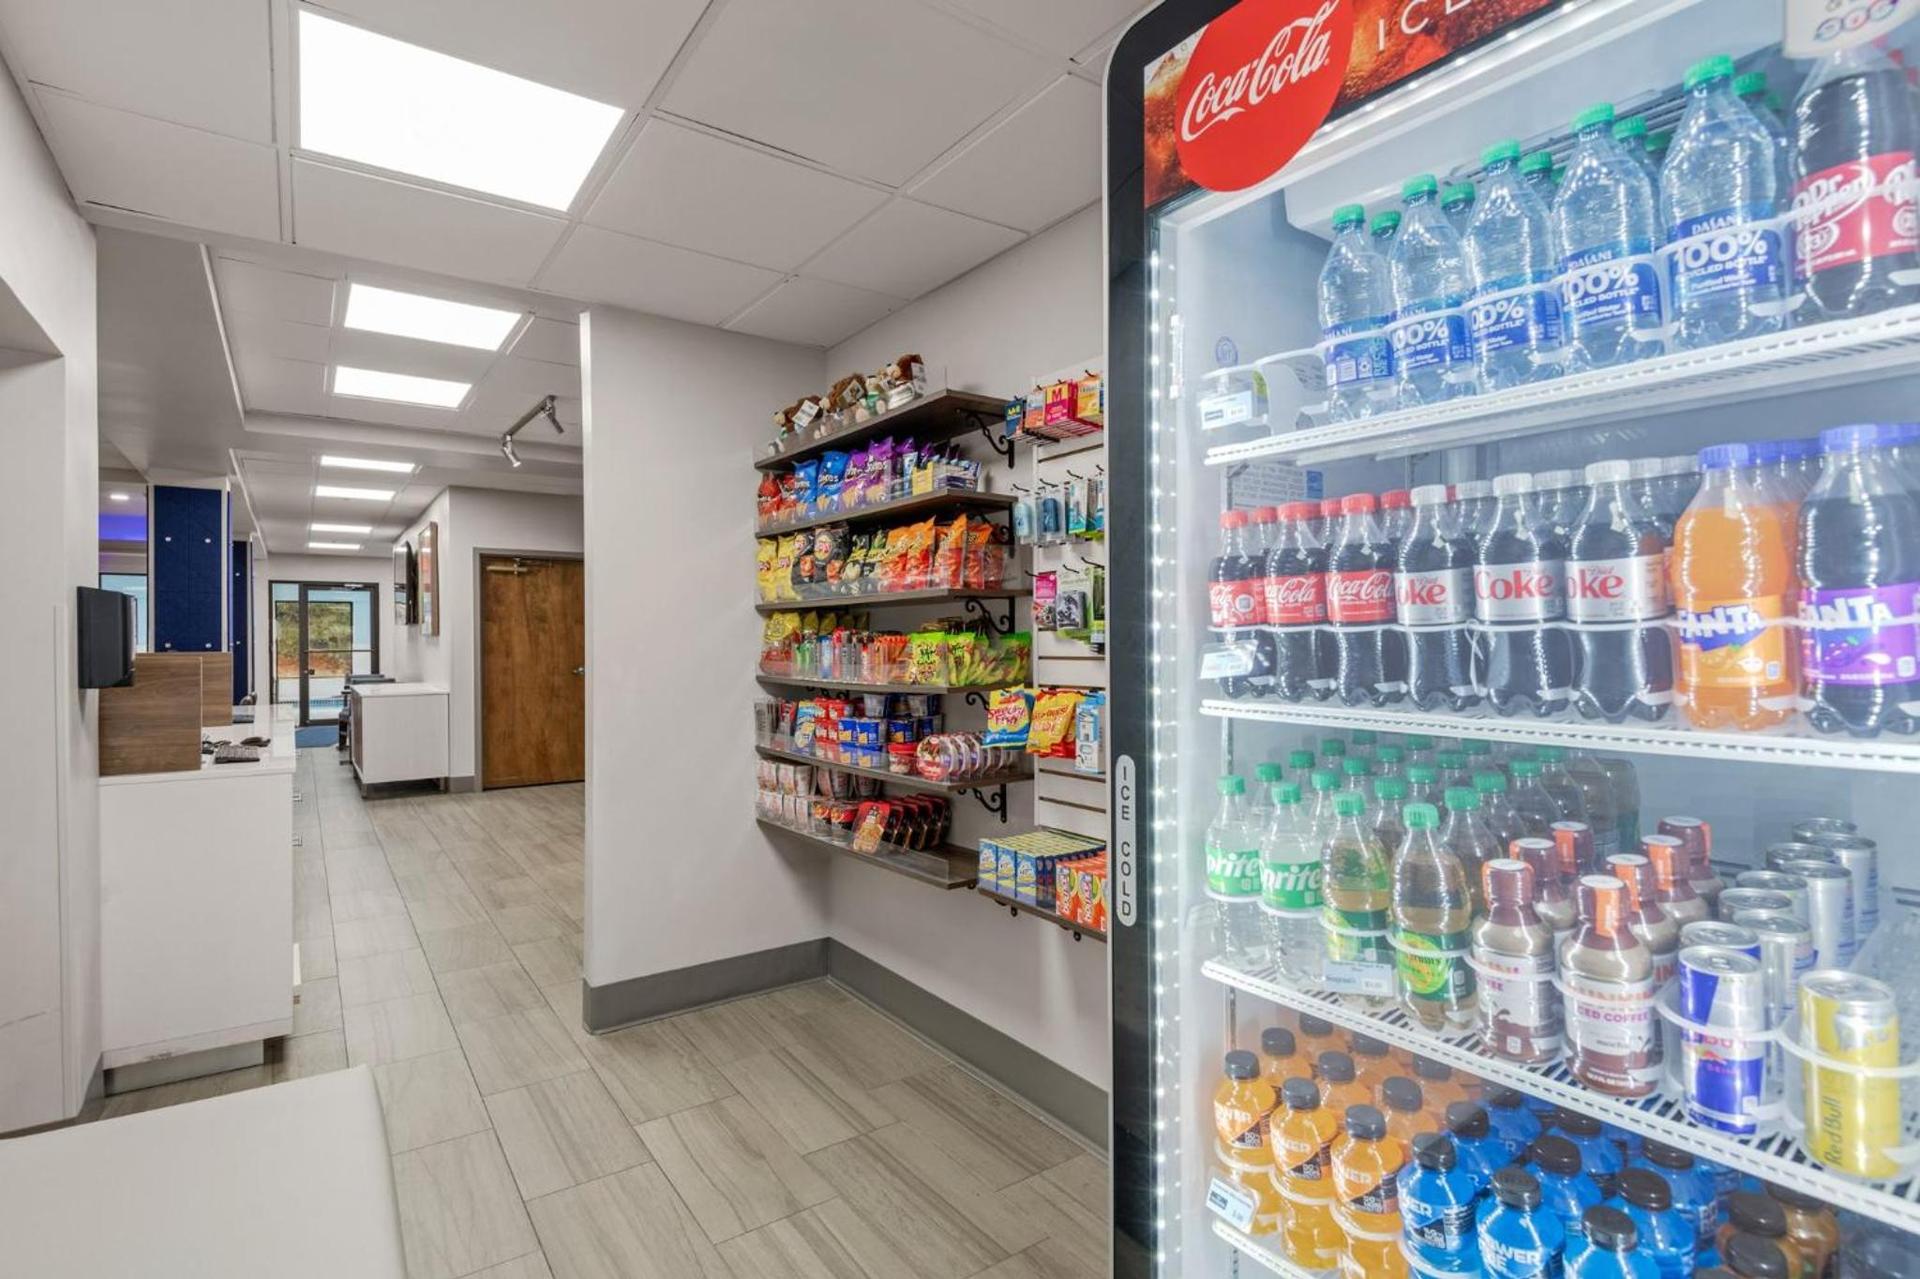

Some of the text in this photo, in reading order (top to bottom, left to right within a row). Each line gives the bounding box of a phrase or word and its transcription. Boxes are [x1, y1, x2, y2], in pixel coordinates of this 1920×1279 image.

[1181, 0, 1340, 142] Coca-Cola
[1674, 229, 1768, 274] 100%
[1475, 569, 1553, 600] Coke
[1120, 766, 1132, 917] ICE COLD
